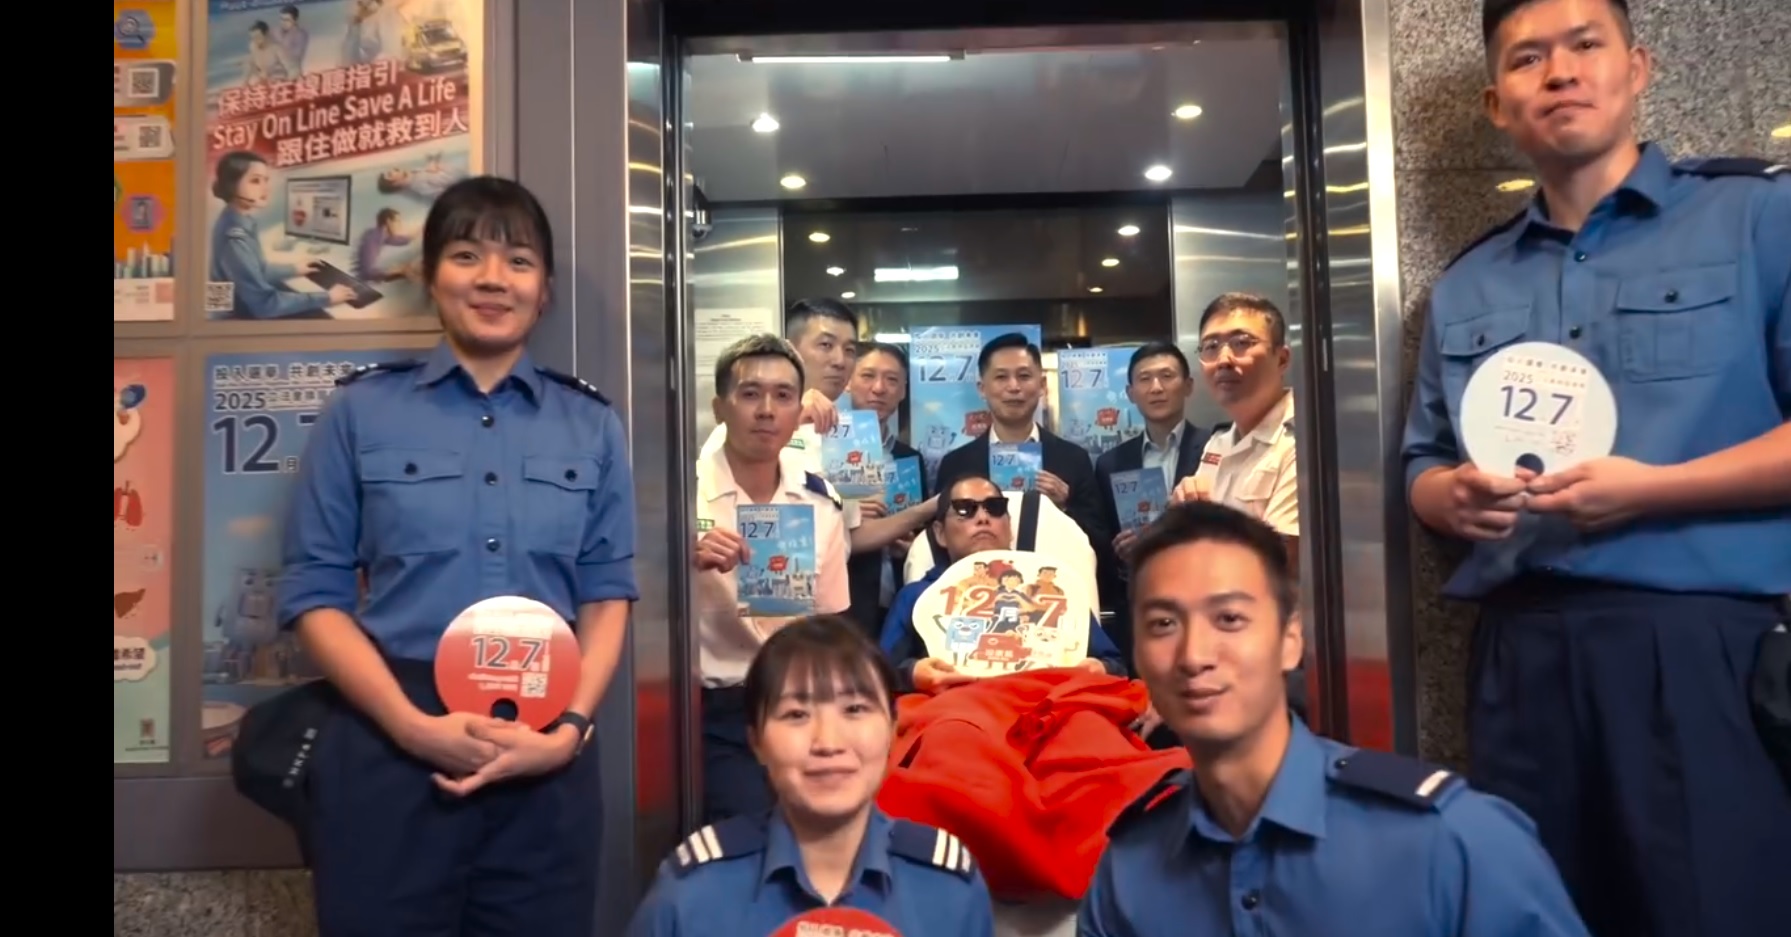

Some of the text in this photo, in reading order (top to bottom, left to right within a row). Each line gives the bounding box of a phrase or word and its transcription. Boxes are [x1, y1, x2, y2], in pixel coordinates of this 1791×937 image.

[213, 76, 457, 151] Stay On Line Save A Life
[277, 106, 468, 167] 跟住做就救到人
[954, 355, 973, 382] 7
[1061, 368, 1102, 389] 12 7
[1503, 370, 1533, 384] 2025
[215, 391, 267, 411] 2025
[1500, 385, 1575, 426] 12 7
[213, 415, 280, 473] 12
[991, 454, 1015, 466] 12 7
[1114, 480, 1138, 494] 12 7
[739, 522, 775, 538] 12 7
[1037, 596, 1068, 629] 7
[472, 636, 542, 670] 12 7
